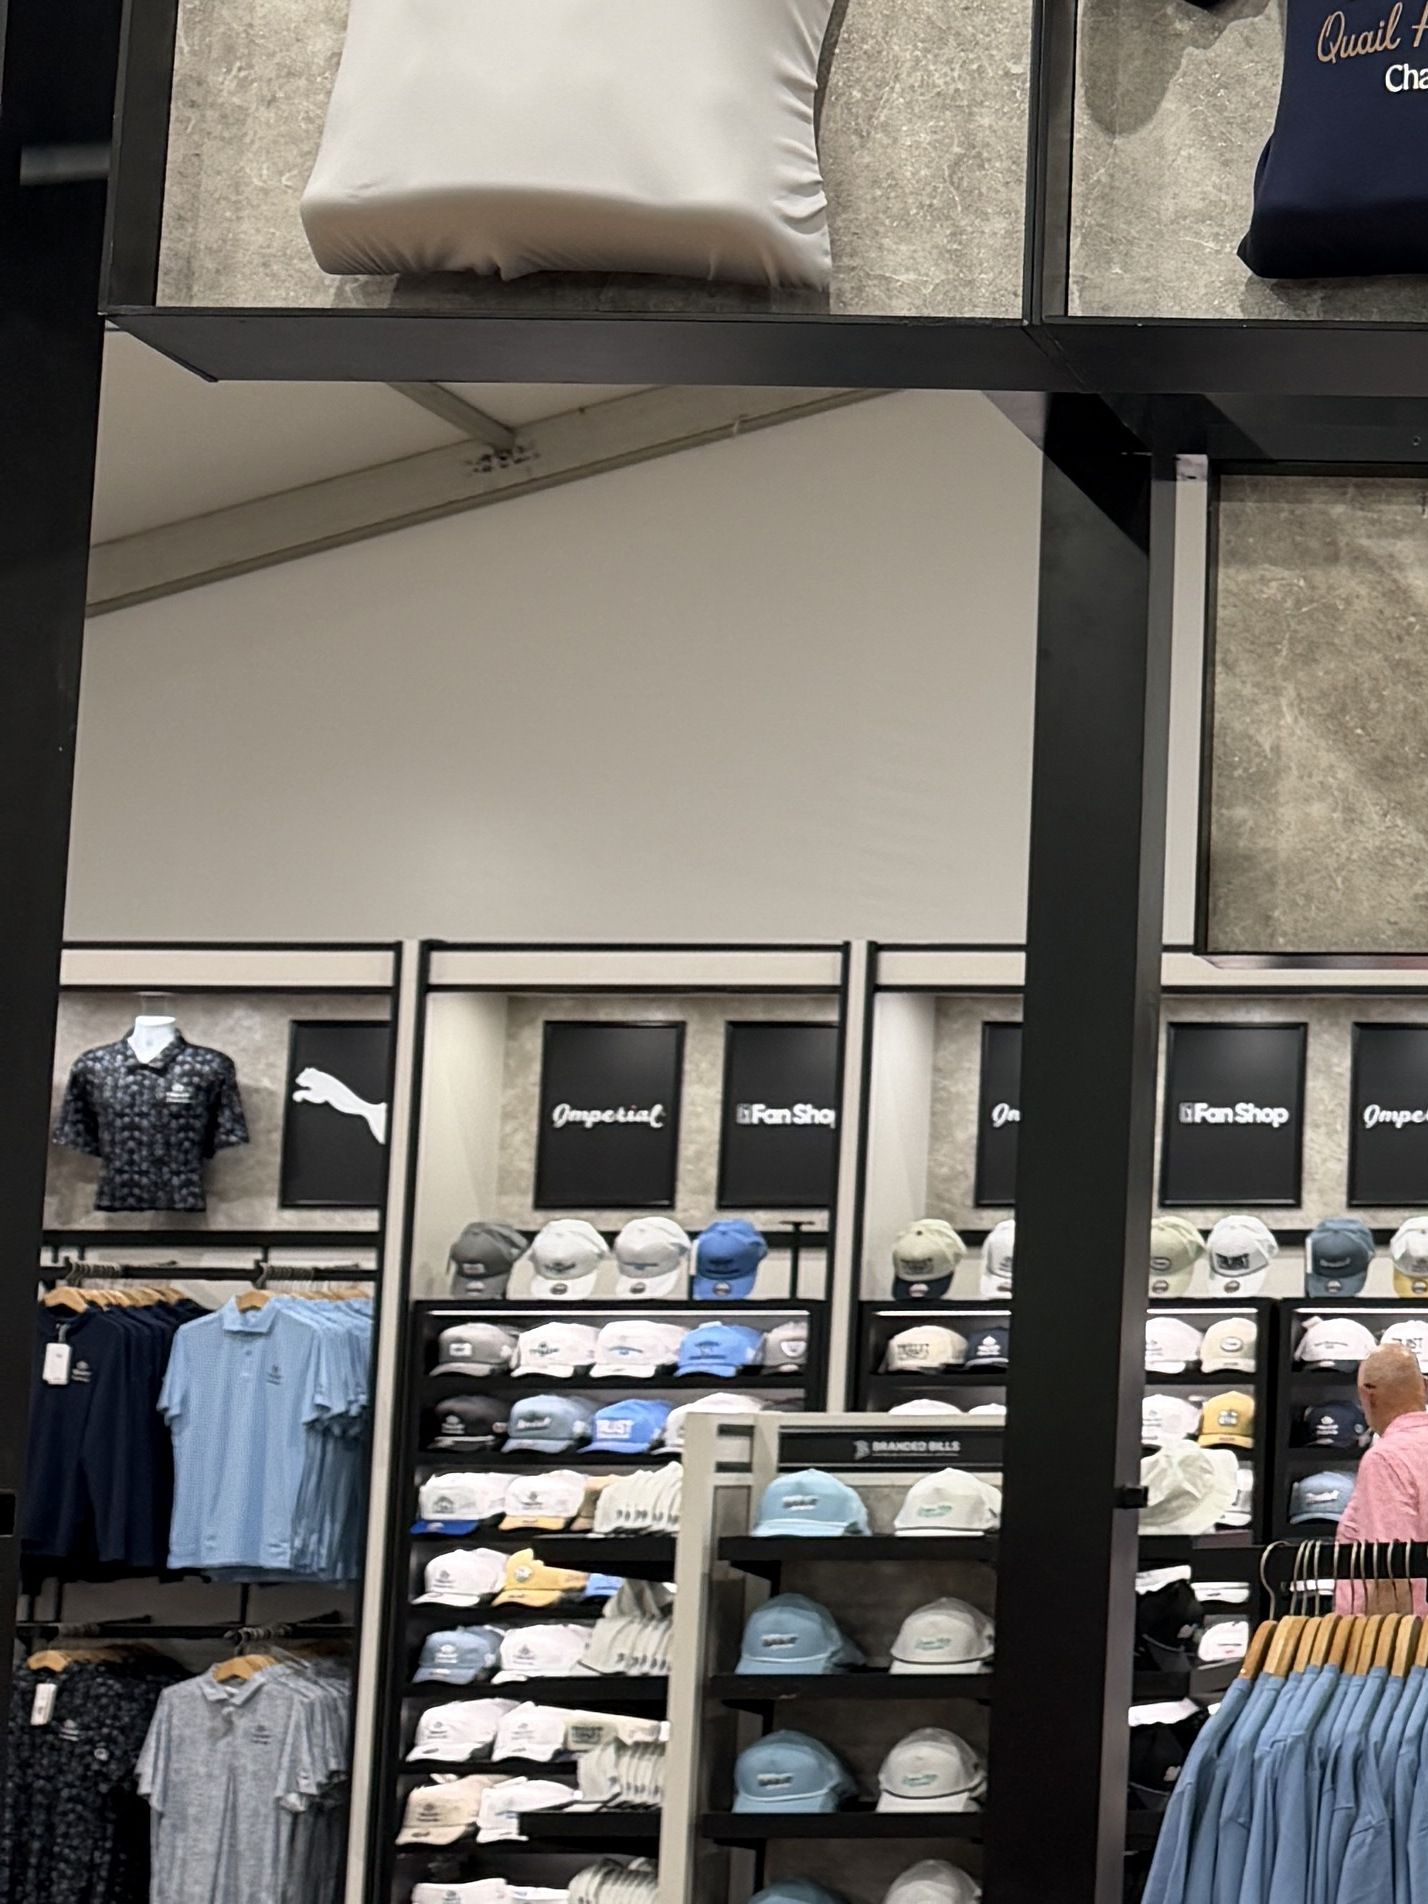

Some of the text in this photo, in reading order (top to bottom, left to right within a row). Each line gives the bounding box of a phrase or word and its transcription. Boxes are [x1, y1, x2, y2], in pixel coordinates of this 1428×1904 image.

[1316, 1, 1402, 64] Quail
[552, 1103, 664, 1128] Imperial
[752, 1105, 790, 1125] Fan
[1195, 1103, 1290, 1128] Fan Shop
[872, 1440, 961, 1452] BRANDED BILLS
